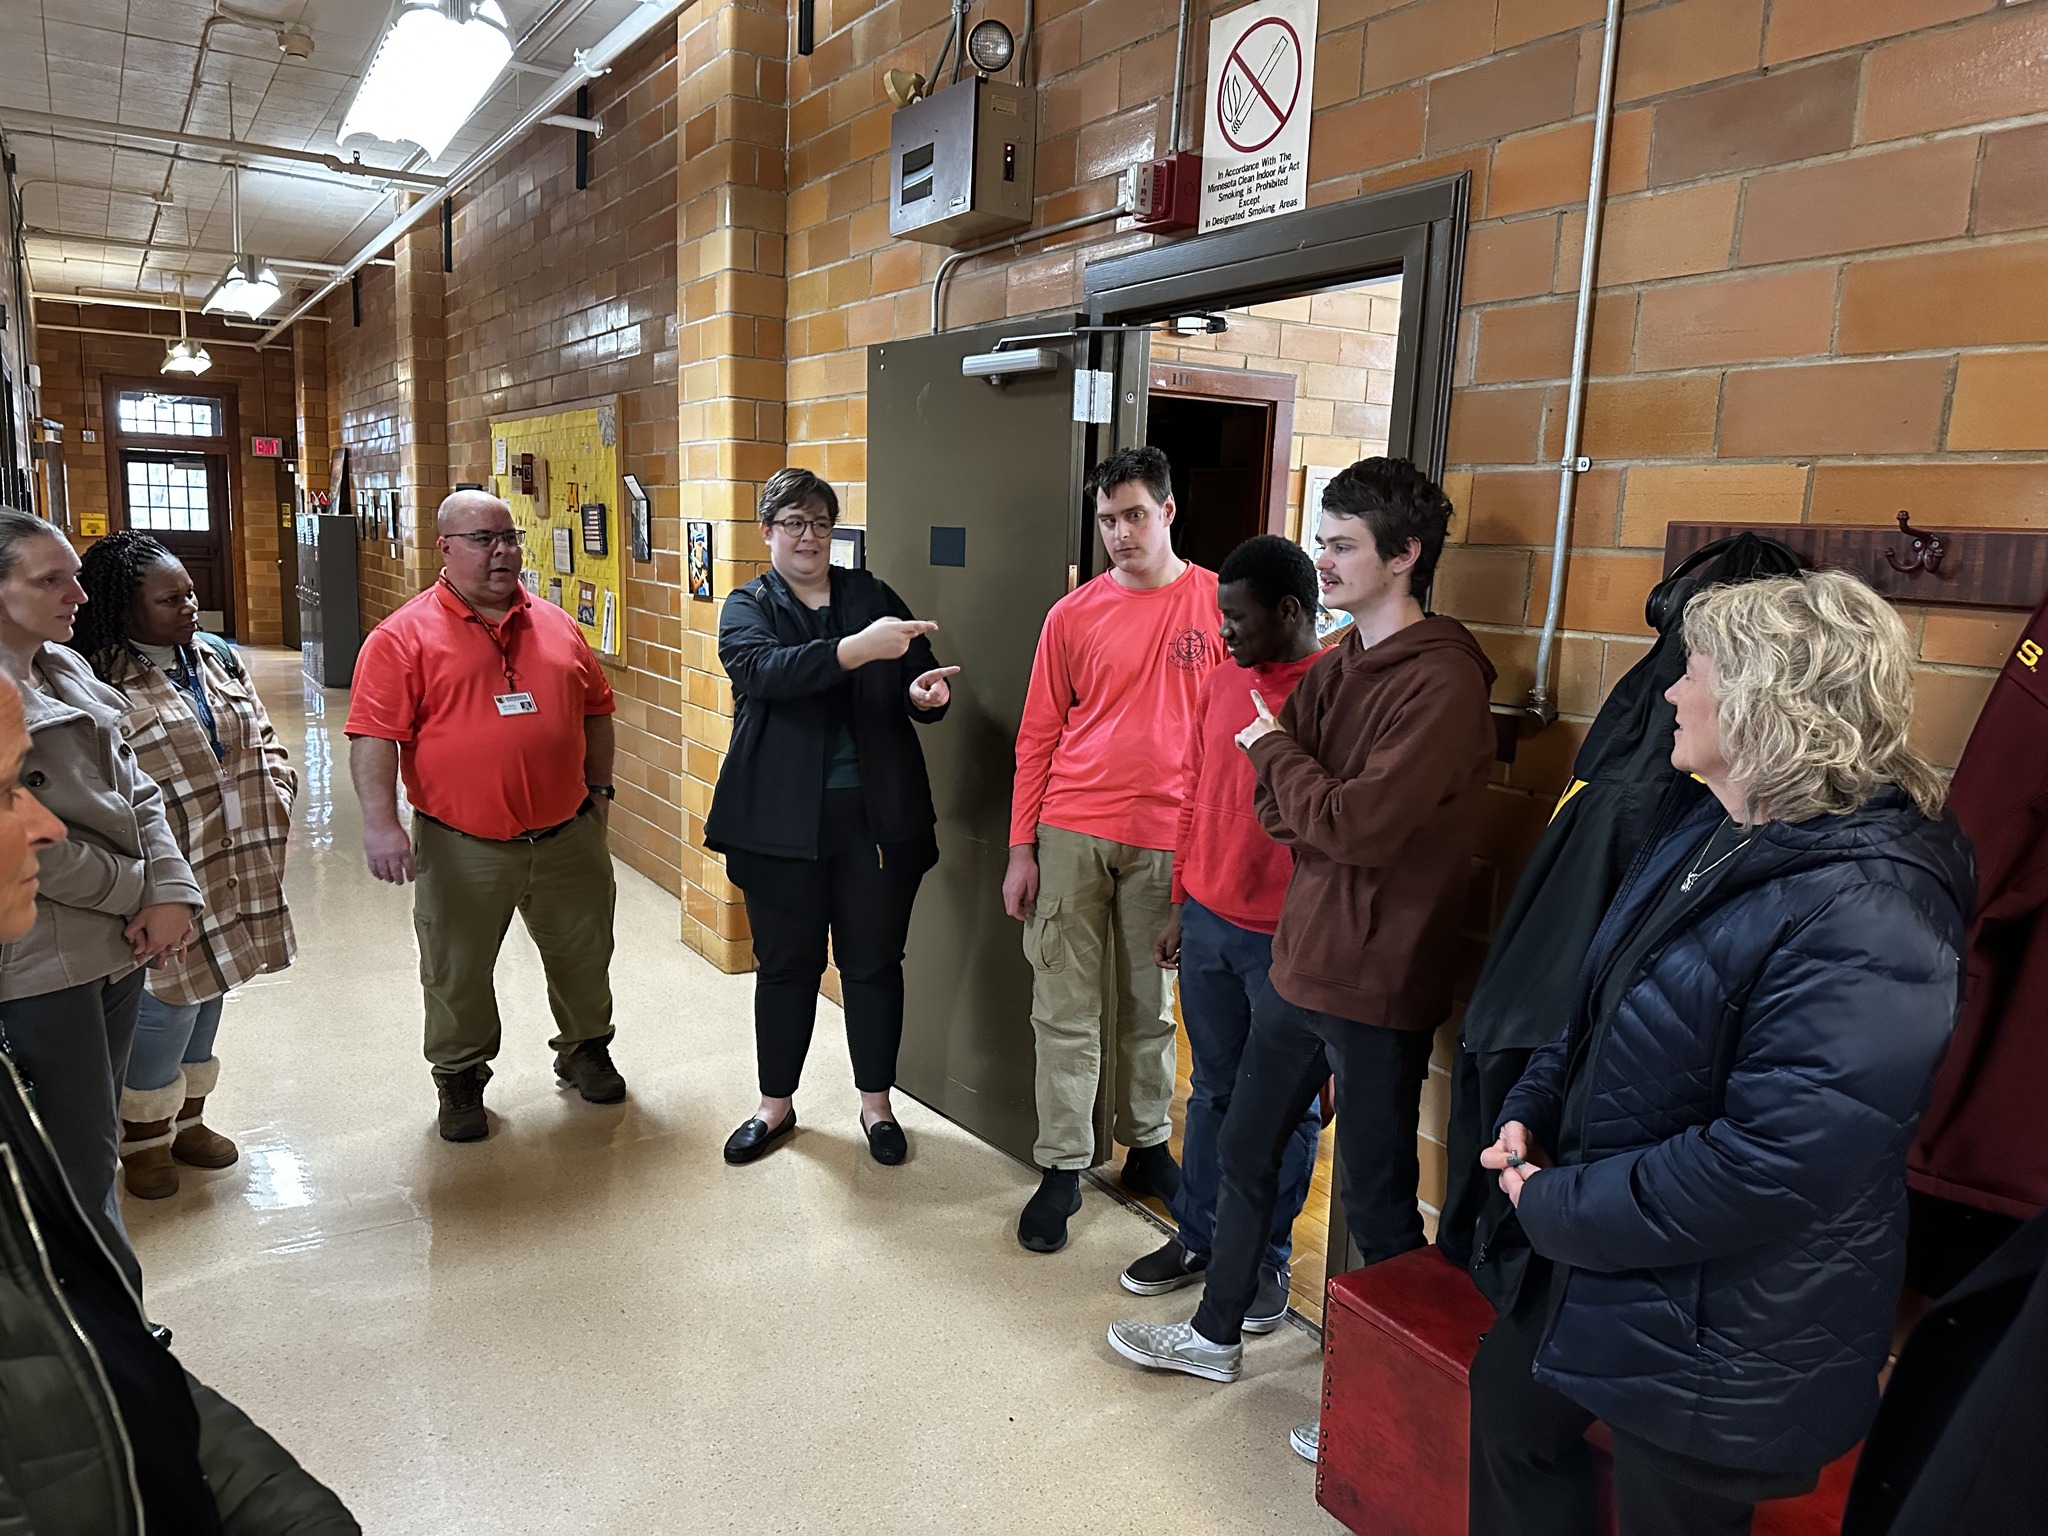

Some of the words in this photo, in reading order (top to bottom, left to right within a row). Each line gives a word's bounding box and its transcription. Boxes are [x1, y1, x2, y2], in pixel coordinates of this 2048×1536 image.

[1207, 178, 1237, 194] Minnesota
[1237, 174, 1255, 186] Clean
[1256, 168, 1277, 180] Indoor
[1277, 164, 1287, 175] Air
[1288, 160, 1300, 172] Act
[1217, 170, 1224, 180] In
[1224, 161, 1260, 177] Accordance
[1261, 155, 1277, 167] With
[1279, 151, 1292, 163] The
[1140, 167, 1149, 207] FIRE
[1218, 188, 1244, 202] Smoking
[1246, 185, 1253, 194] is
[1255, 176, 1289, 193] Prohibited
[1238, 194, 1260, 208] Except
[1205, 219, 1211, 228] In
[1211, 209, 1245, 227] Designated
[1247, 203, 1276, 217] Smoking
[1278, 198, 1298, 210] Areas
[255, 438, 279, 456] EXIT
